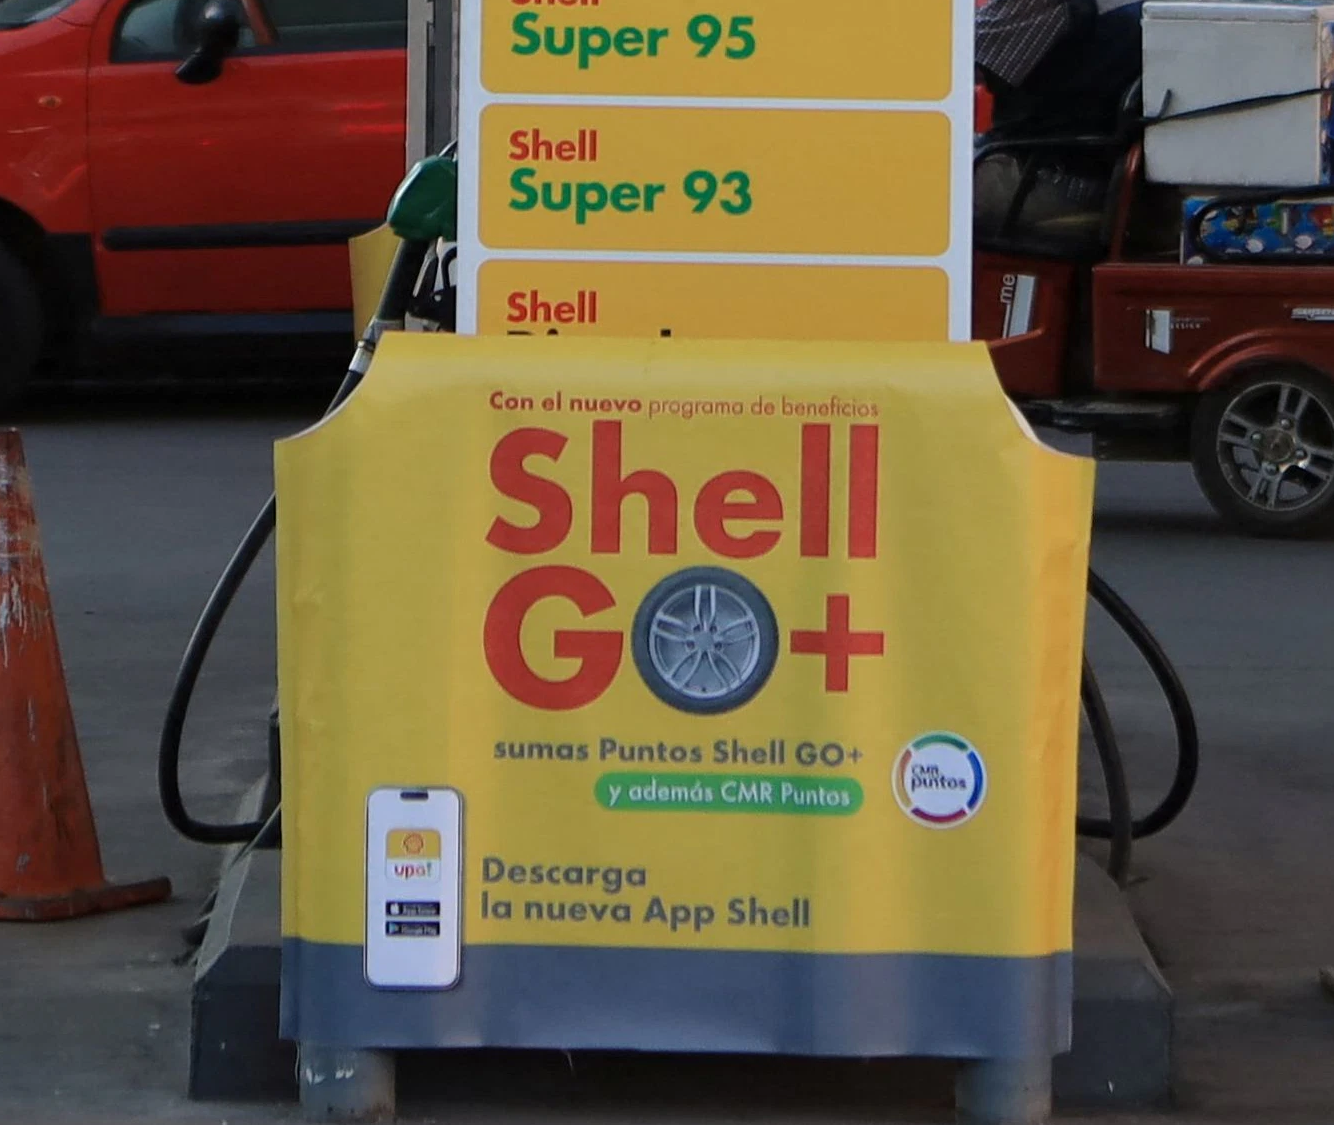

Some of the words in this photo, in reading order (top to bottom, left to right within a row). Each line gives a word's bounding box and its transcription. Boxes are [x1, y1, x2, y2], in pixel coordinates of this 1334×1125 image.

[511, 11, 669, 71] Super
[686, 13, 757, 61] 95
[509, 127, 598, 162] Shell
[509, 167, 666, 225] Super
[682, 169, 753, 216] 93
[507, 289, 598, 324] Shell
[489, 391, 534, 412] Con
[541, 391, 562, 412] el
[569, 397, 643, 413] nuevo
[647, 399, 745, 420] programa
[750, 395, 776, 416] de
[781, 395, 880, 418] beneficios
[484, 418, 880, 560] Shell
[493, 738, 589, 761] sumas
[598, 737, 704, 763] Puntos
[712, 739, 786, 765] Shell
[794, 742, 864, 767] GO+
[609, 784, 621, 805] y
[628, 777, 714, 804] además
[721, 780, 772, 805] CMR
[780, 785, 851, 807] Puntos
[911, 775, 967, 792] puntos
[482, 856, 647, 894] Descarga
[481, 890, 512, 920] la
[523, 899, 632, 922] nueva
[643, 896, 715, 932] App
[727, 896, 810, 928] Shell
